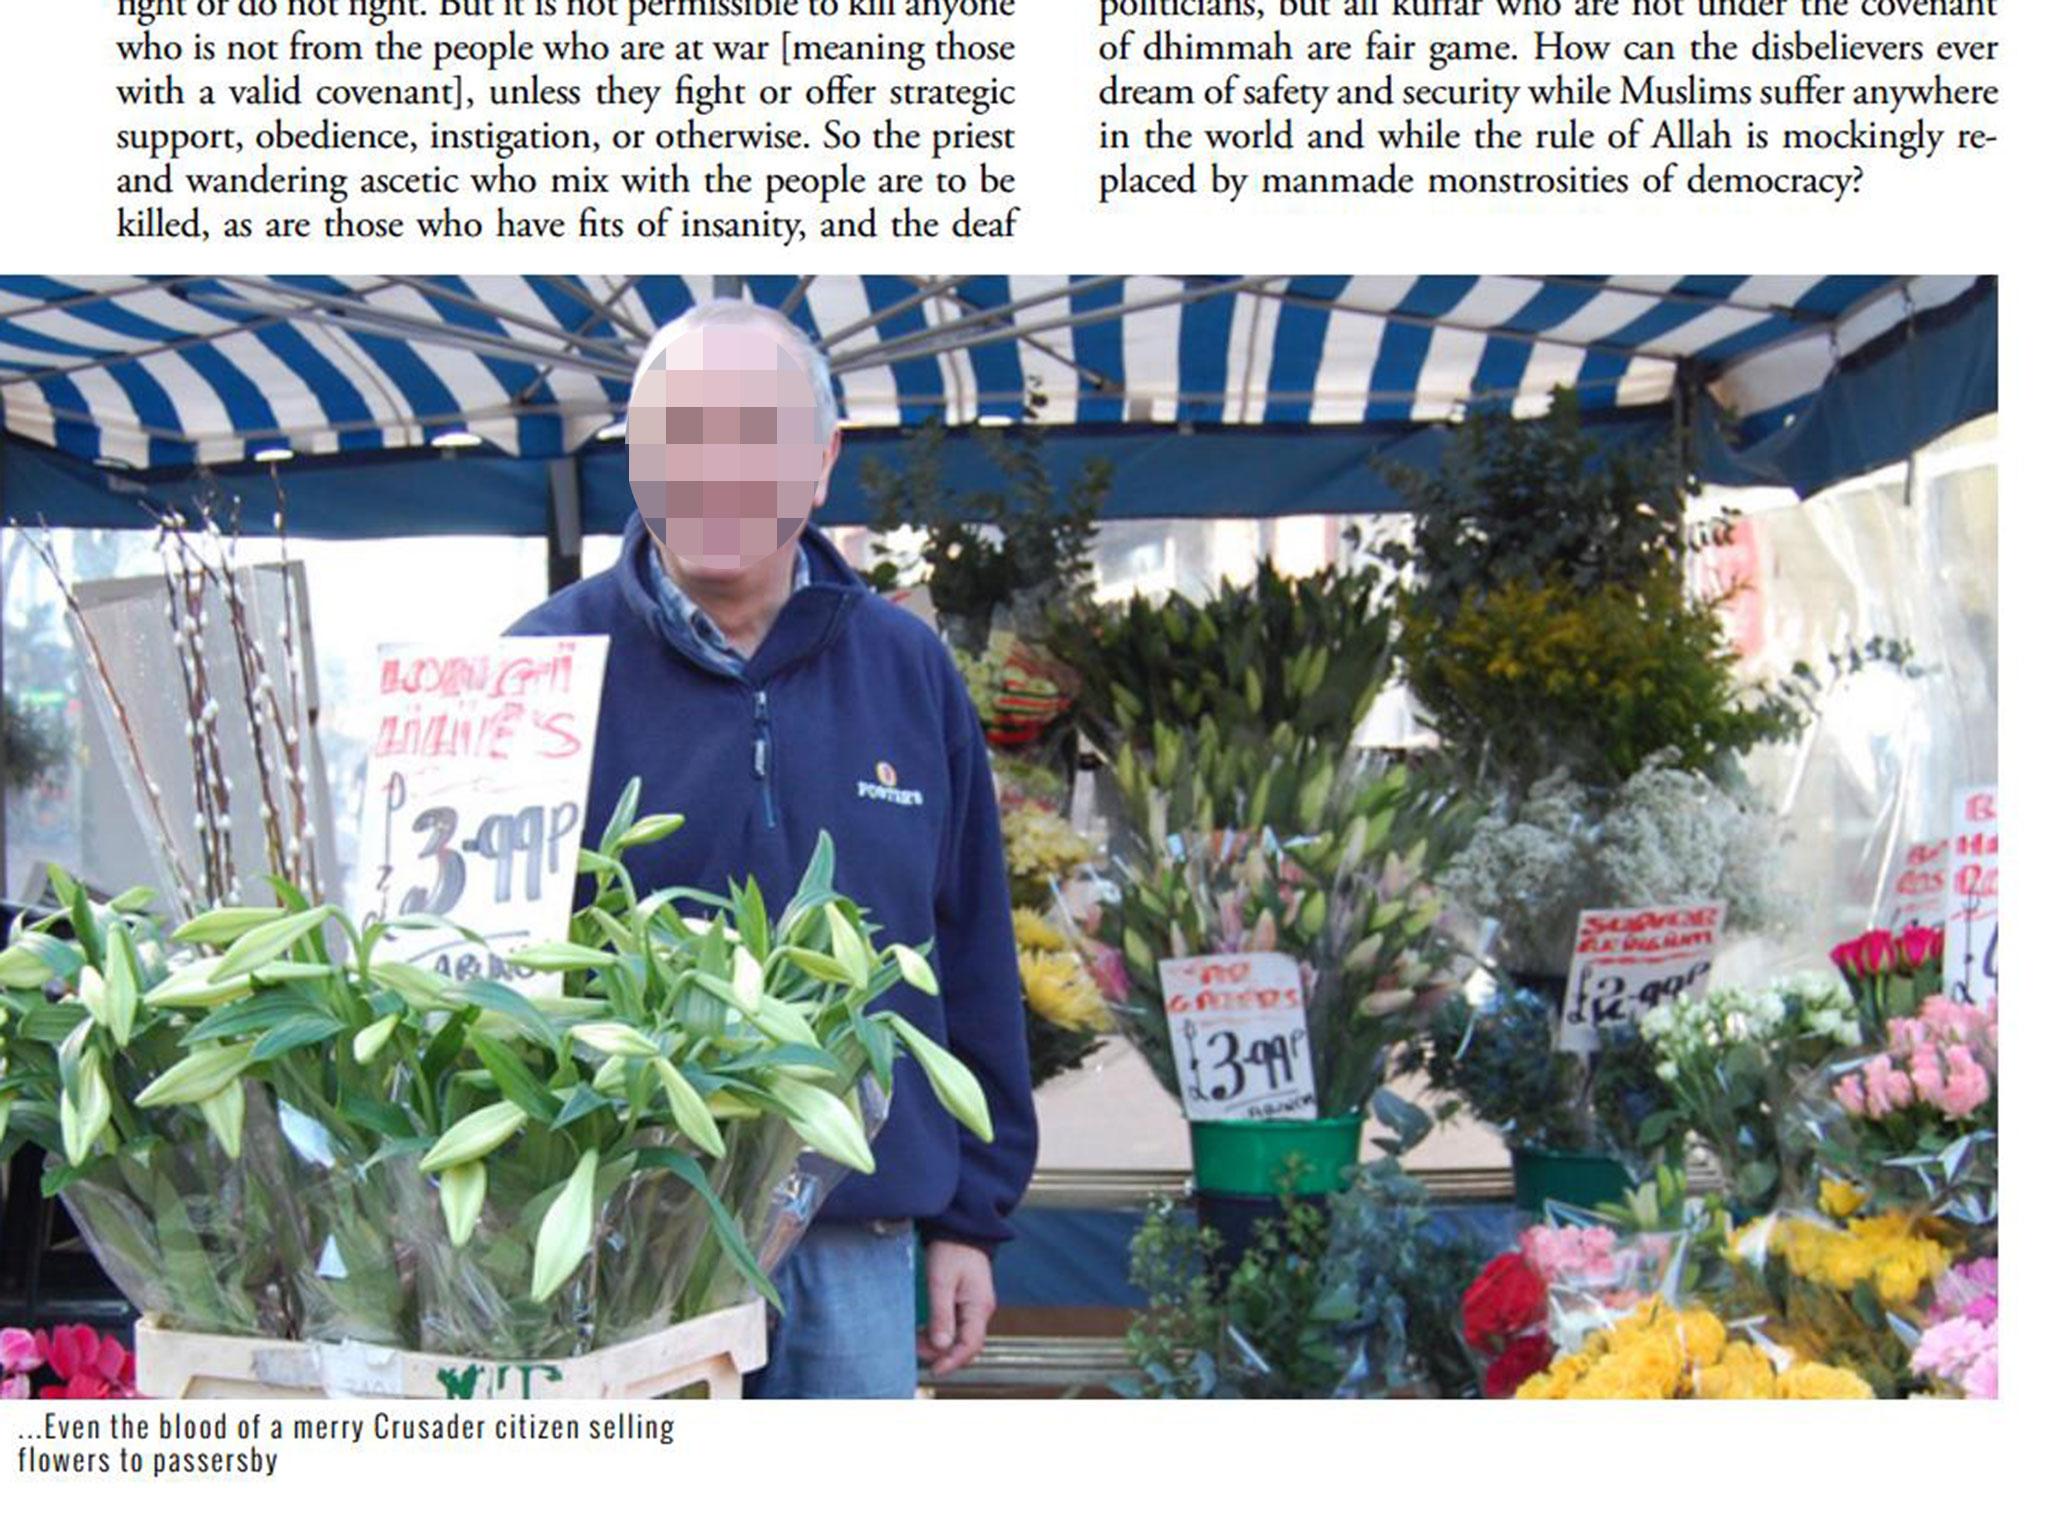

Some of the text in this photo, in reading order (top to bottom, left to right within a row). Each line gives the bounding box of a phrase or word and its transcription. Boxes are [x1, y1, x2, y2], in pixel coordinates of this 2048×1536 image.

[196, 0, 230, 16] or
[287, 0, 339, 16] not
[504, 0, 525, 16] it
[535, 0, 557, 16] is
[567, 0, 618, 16] not
[809, 0, 839, 16] to
[905, 0, 1015, 26] anyone
[1574, 0, 1619, 17] are
[1632, 0, 1684, 16] not
[1861, 0, 1997, 17] covenant
[115, 28, 1015, 71] who is not from the people who are at war [meaning those
[1099, 29, 1999, 71] of dhimmah are fair game. How can the disbelievers ever
[116, 73, 1016, 114] with a valid covenant], unless they fight or offer strategic
[1099, 73, 1999, 114] dream of safety and security while Muslims suffer anywhere
[116, 118, 1015, 159] support, obedience, instigation, or otherwise. So the priest
[1100, 117, 1997, 159] in the world and while the rule of Allah is mockingly re-
[117, 162, 1016, 203] and wandering ascetic who mix with the people are to be
[1099, 161, 1864, 204] placed by manmade monstrosities of democracy?
[117, 206, 1021, 247] killed, as are those who have fits of insanity, and the deaf
[110, 1412, 149, 1440] the
[159, 1412, 226, 1440] blood
[238, 1413, 261, 1440] of
[270, 1419, 282, 1440] a
[294, 1419, 364, 1444] merry
[374, 1412, 485, 1440] Crusader
[495, 1413, 579, 1440] citizen
[589, 1412, 674, 1445] selling
[18, 1446, 278, 1478] flowers to passersby
